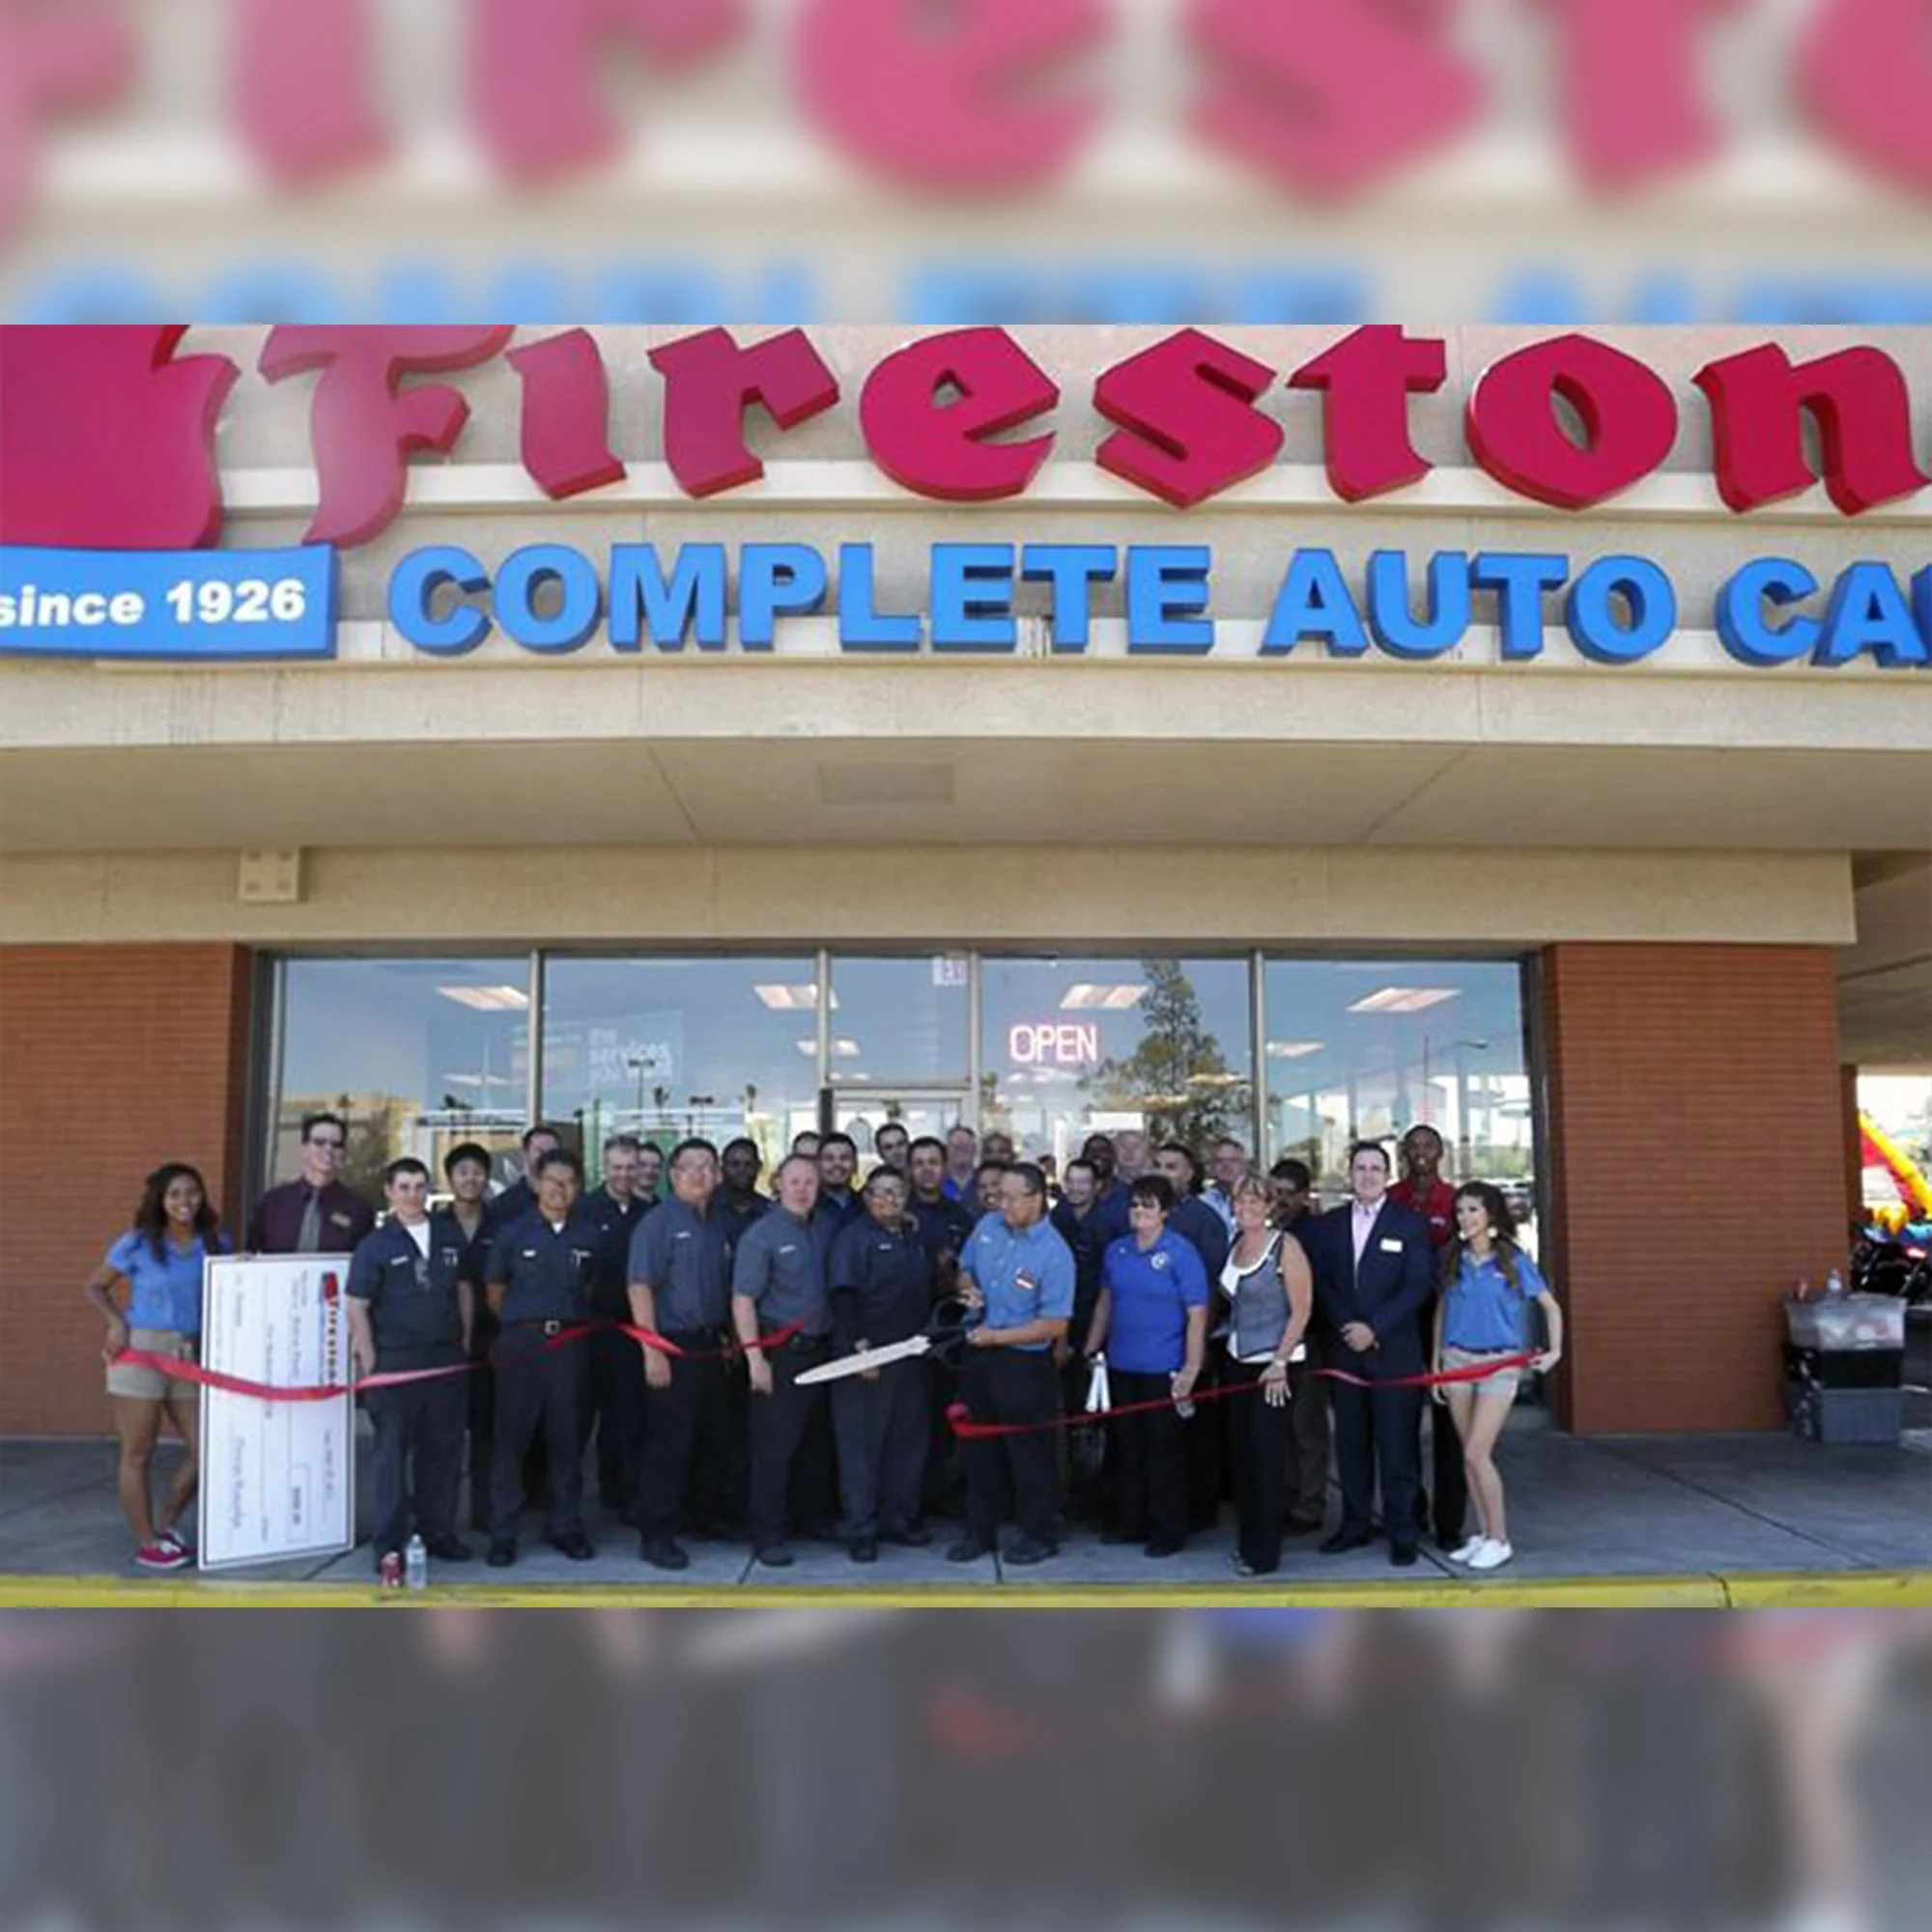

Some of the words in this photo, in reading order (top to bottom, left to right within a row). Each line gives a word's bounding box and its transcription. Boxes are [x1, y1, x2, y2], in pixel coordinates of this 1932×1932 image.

[166, 579, 305, 623] 1926
[388, 542, 1214, 655] COMPLETE
[1259, 548, 1677, 663] AUTO
[1715, 556, 1932, 668] CA
[1009, 1024, 1097, 1063] OPEN
